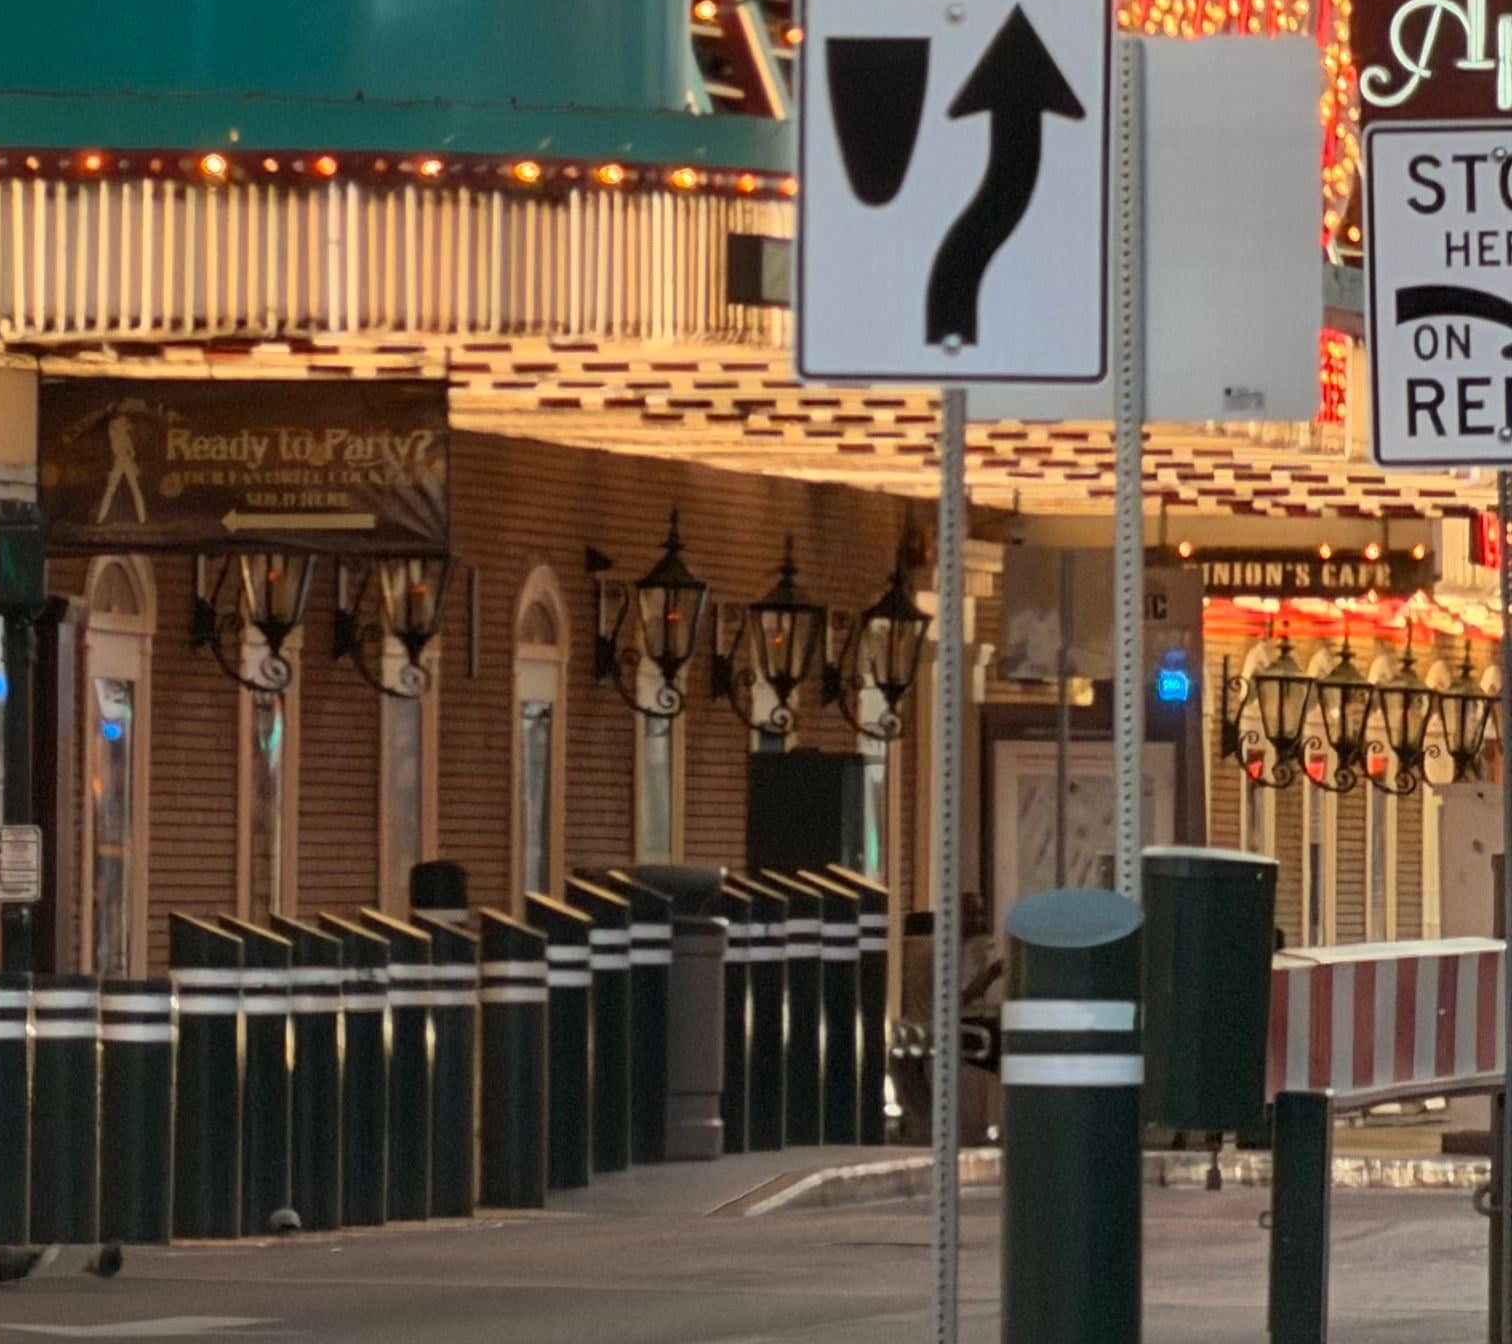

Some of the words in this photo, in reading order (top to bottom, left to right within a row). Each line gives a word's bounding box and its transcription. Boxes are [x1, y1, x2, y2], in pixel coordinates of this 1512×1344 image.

[1445, 230, 1512, 268] HE
[1414, 323, 1472, 361] ON
[1406, 376, 1512, 438] RE
[166, 427, 268, 469] Ready
[278, 427, 314, 461] to
[1194, 561, 1311, 587] INION'S
